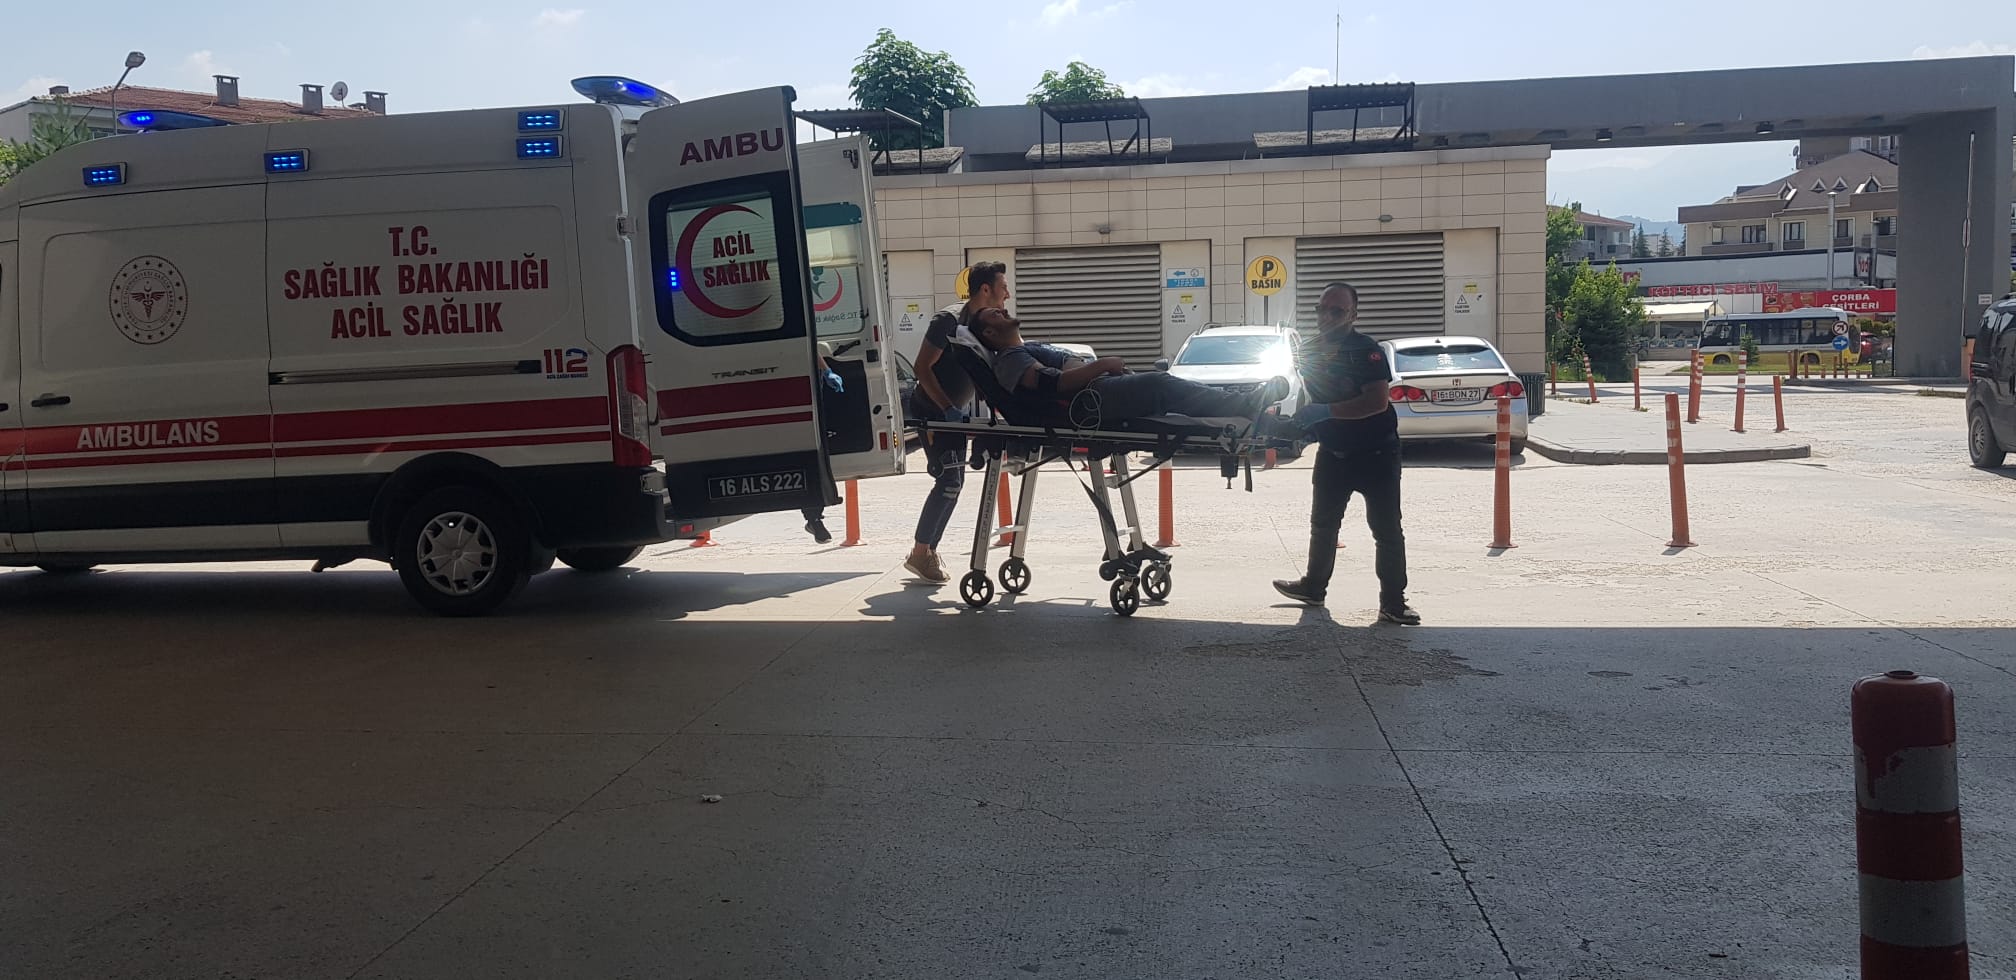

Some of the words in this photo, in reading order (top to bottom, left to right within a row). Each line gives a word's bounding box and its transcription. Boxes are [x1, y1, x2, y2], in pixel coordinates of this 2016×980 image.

[680, 128, 784, 166] AMBU
[388, 226, 437, 256] T.C.
[713, 230, 755, 258] ACİL
[284, 260, 382, 300] SAĞLIK
[398, 252, 549, 295] BAKANLIĞI
[703, 259, 771, 288] SAĞLIK
[1262, 260, 1274, 277] P
[1251, 279, 1281, 289] BASIN
[1832, 293, 1870, 303] ÇORBA
[331, 301, 392, 339] ACİL
[403, 297, 504, 336] SAĞLIK
[544, 348, 588, 373] 112
[711, 366, 780, 379] TRANSIT
[1469, 390, 1479, 398] 27
[77, 420, 219, 449] AMBULANS
[719, 479, 736, 496] 16
[741, 476, 770, 494] ALS
[773, 472, 803, 491] 222
